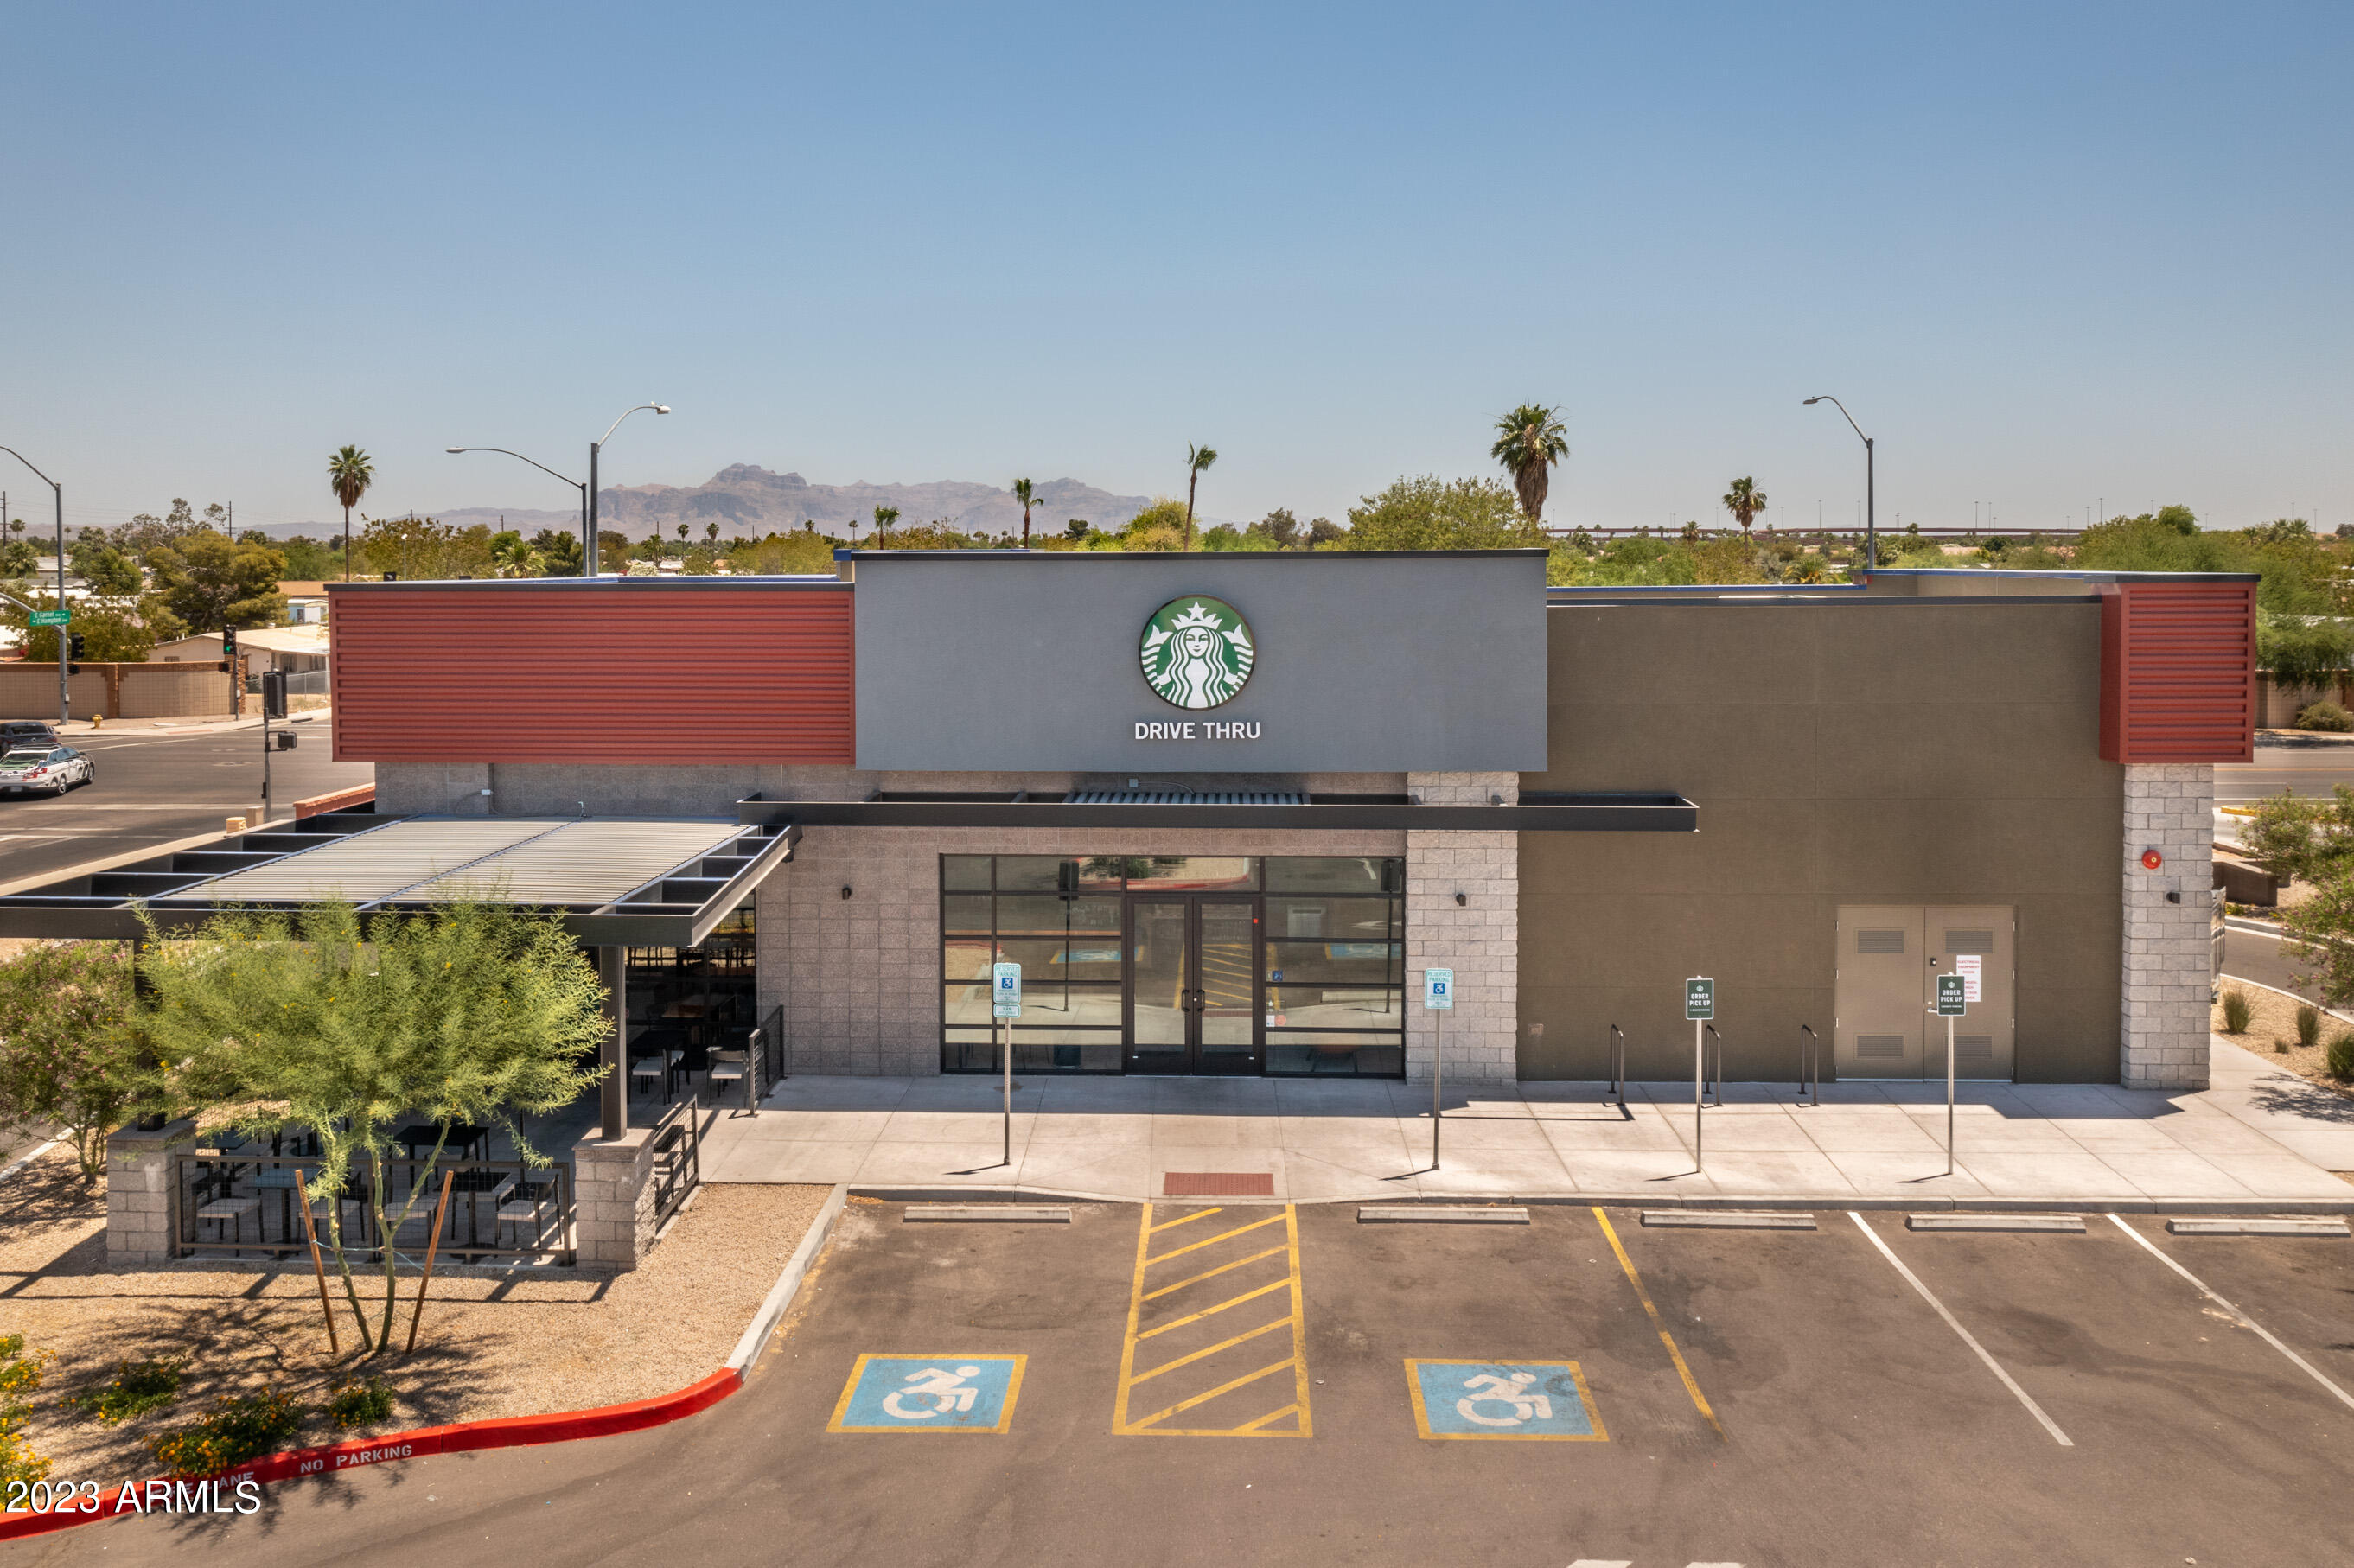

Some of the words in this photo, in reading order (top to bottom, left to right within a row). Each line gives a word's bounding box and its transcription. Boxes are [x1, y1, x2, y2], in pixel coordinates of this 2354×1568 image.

[1134, 723, 1196, 740] DRIVE
[1203, 722, 1260, 740] THRU
[300, 1459, 324, 1474] NO
[335, 1444, 412, 1467] PARKING
